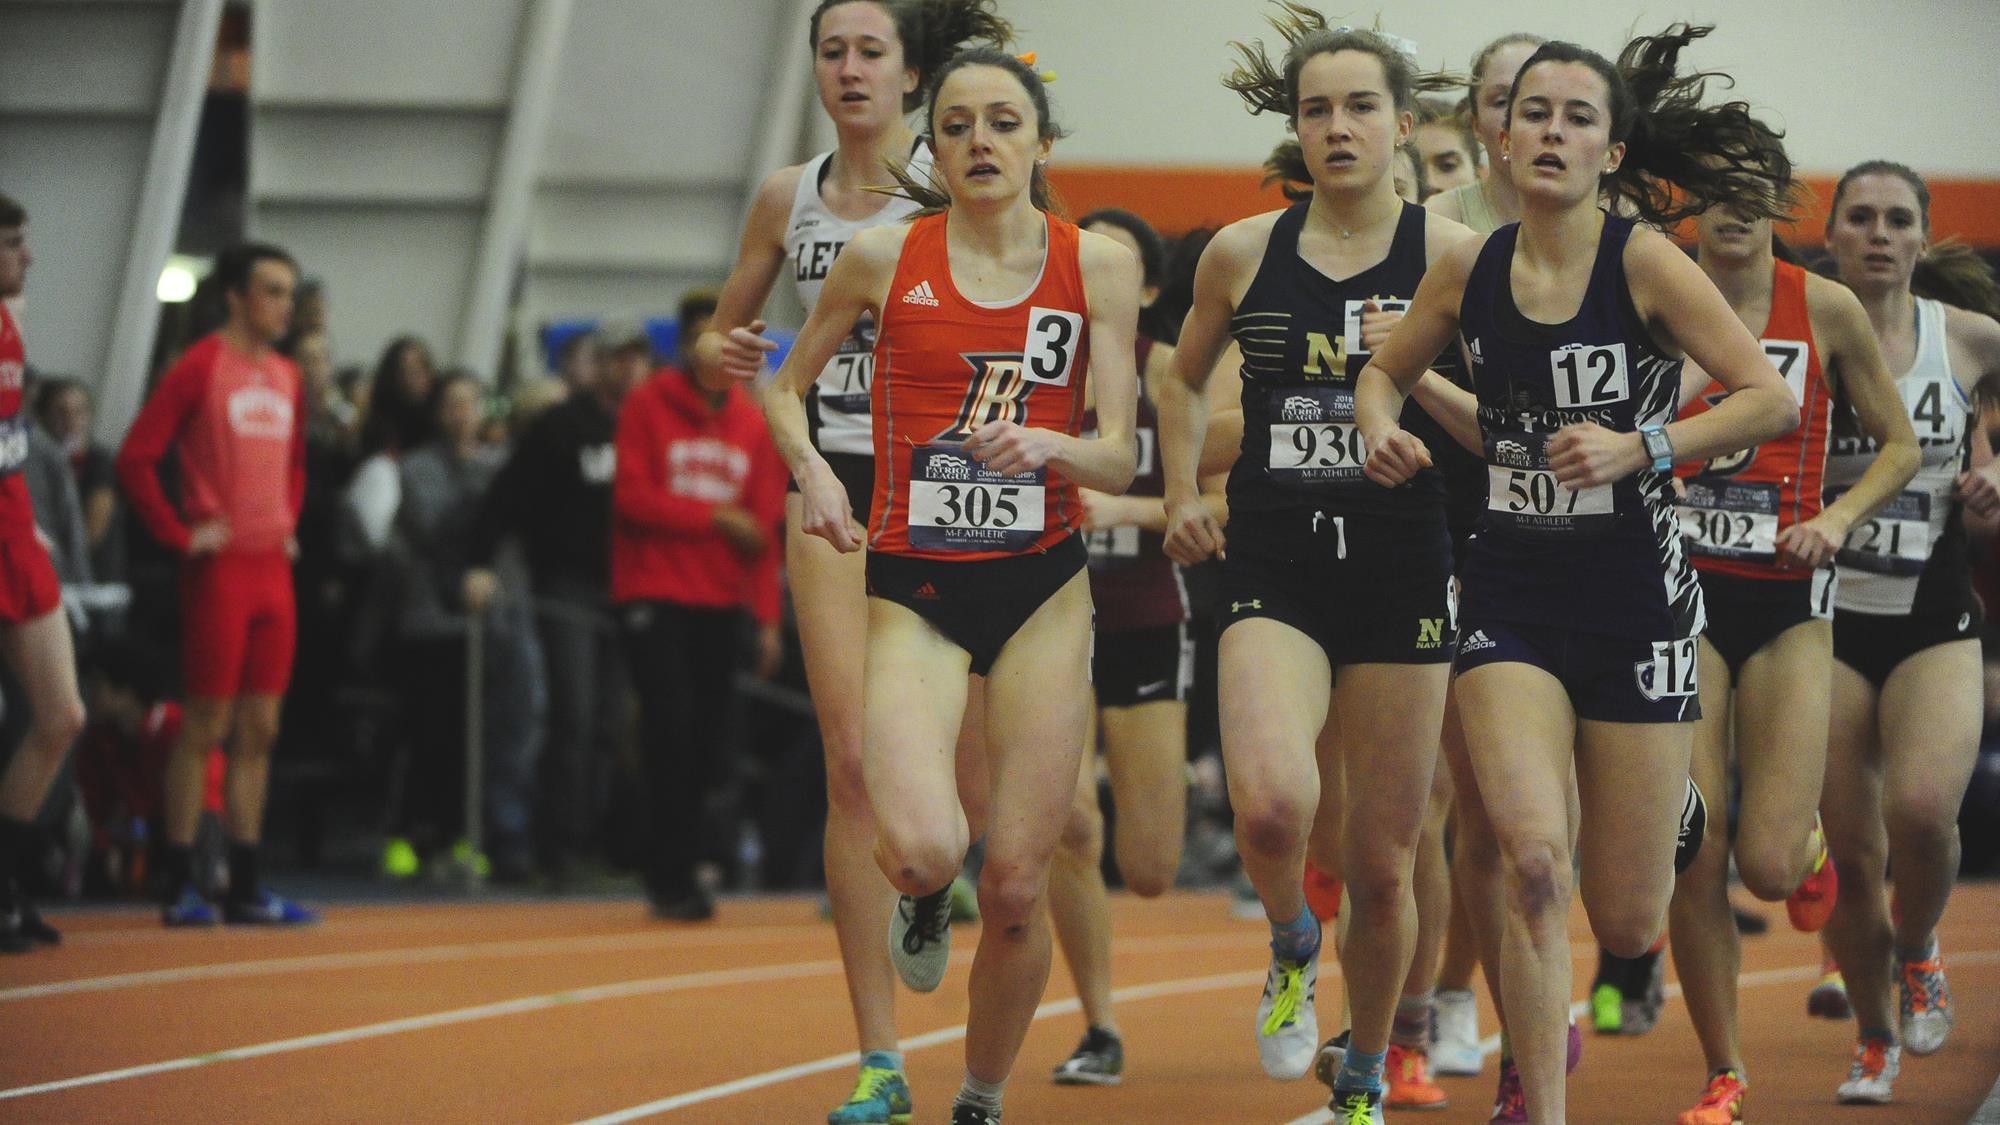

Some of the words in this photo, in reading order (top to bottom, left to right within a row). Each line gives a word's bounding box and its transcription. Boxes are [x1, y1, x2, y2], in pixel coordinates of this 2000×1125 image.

[903, 295, 940, 307] adidas
[1031, 315, 1072, 380] 3
[1303, 332, 1347, 377] N
[1557, 349, 1619, 404] 12
[928, 352, 1036, 443] B
[1914, 382, 1945, 433] 4
[1543, 409, 1616, 428] CROSS
[1292, 426, 1369, 466] 930
[925, 465, 971, 475] PATRIOT
[925, 470, 971, 480] LEAGUE
[934, 485, 1020, 528] 305
[963, 529, 1007, 539] ATHLETIC
[1689, 510, 1754, 549] 302
[1415, 641, 1442, 649] NAVY
[1417, 618, 1444, 641] N
[1460, 641, 1497, 655] adidas
[1659, 640, 1696, 693] 12
